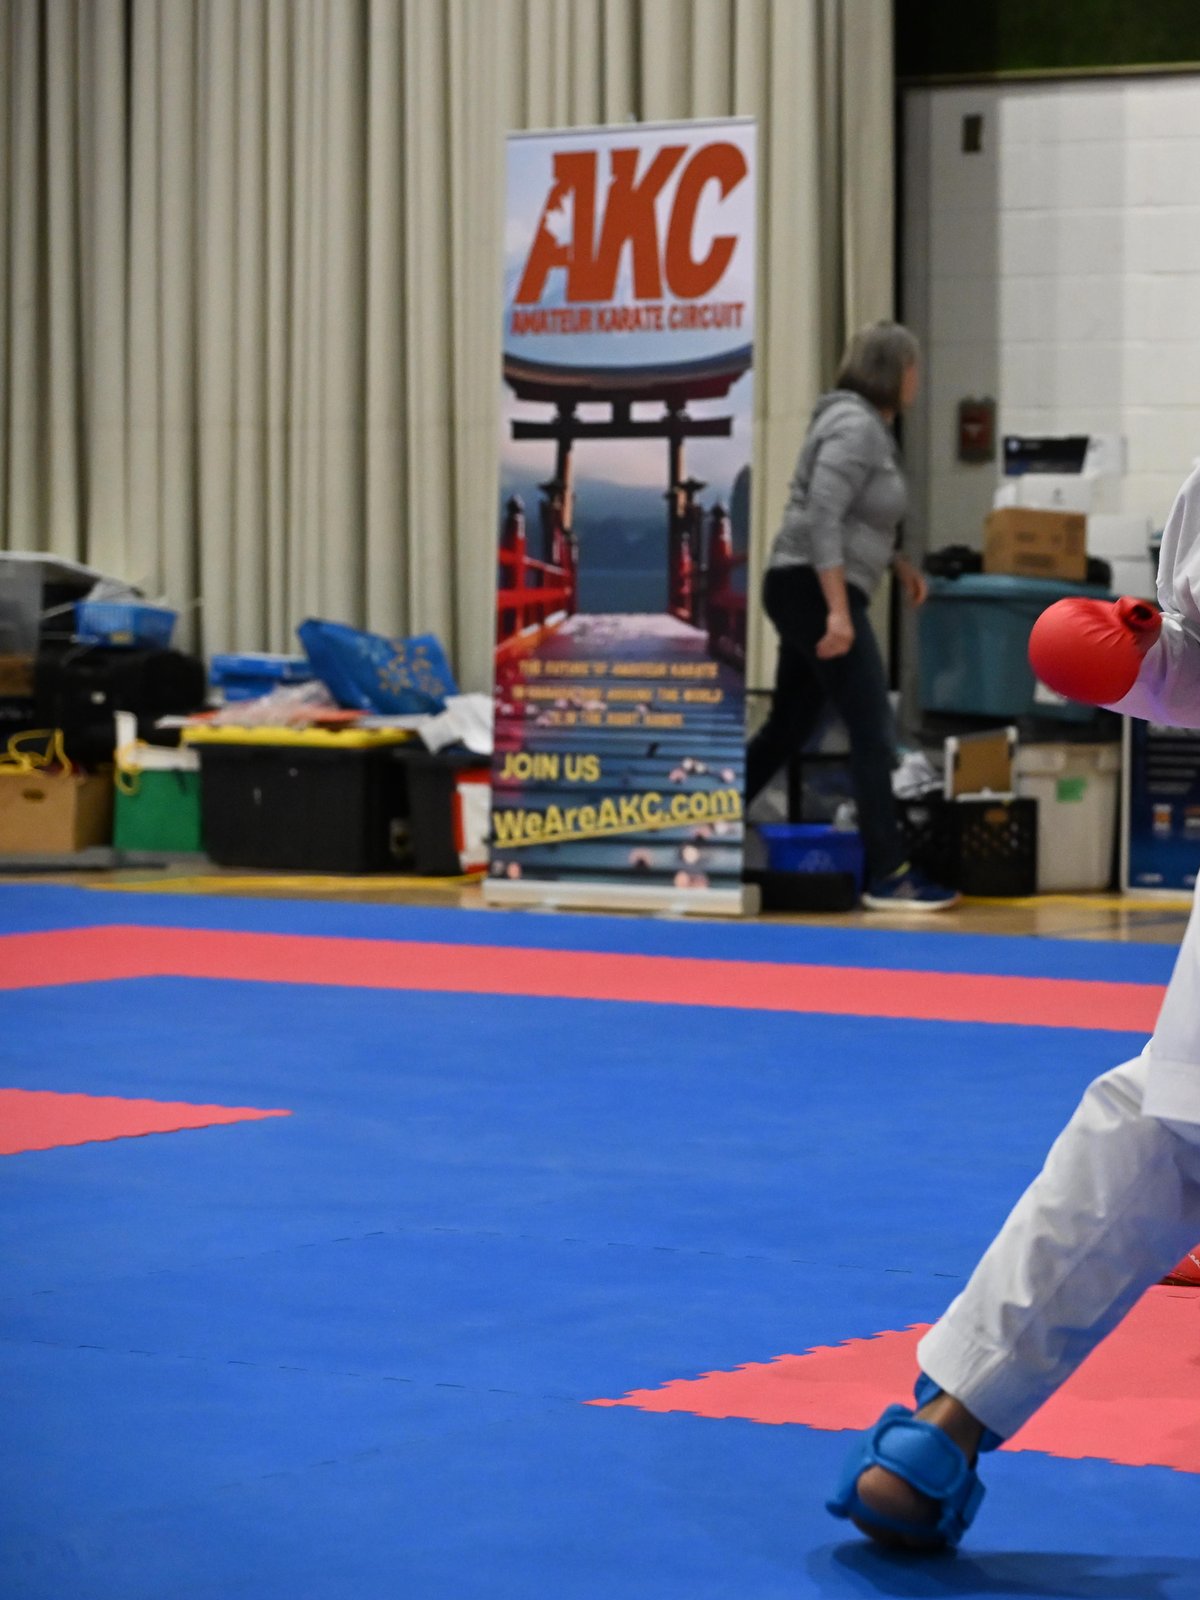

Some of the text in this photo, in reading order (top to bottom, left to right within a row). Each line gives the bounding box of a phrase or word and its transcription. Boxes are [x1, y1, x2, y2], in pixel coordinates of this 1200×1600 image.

[514, 140, 748, 305] AKC
[511, 302, 745, 336] AMATEUR KARATE CIRCUIT
[500, 753, 601, 782] JOIN US
[493, 789, 742, 842] WeAreAKC.com
